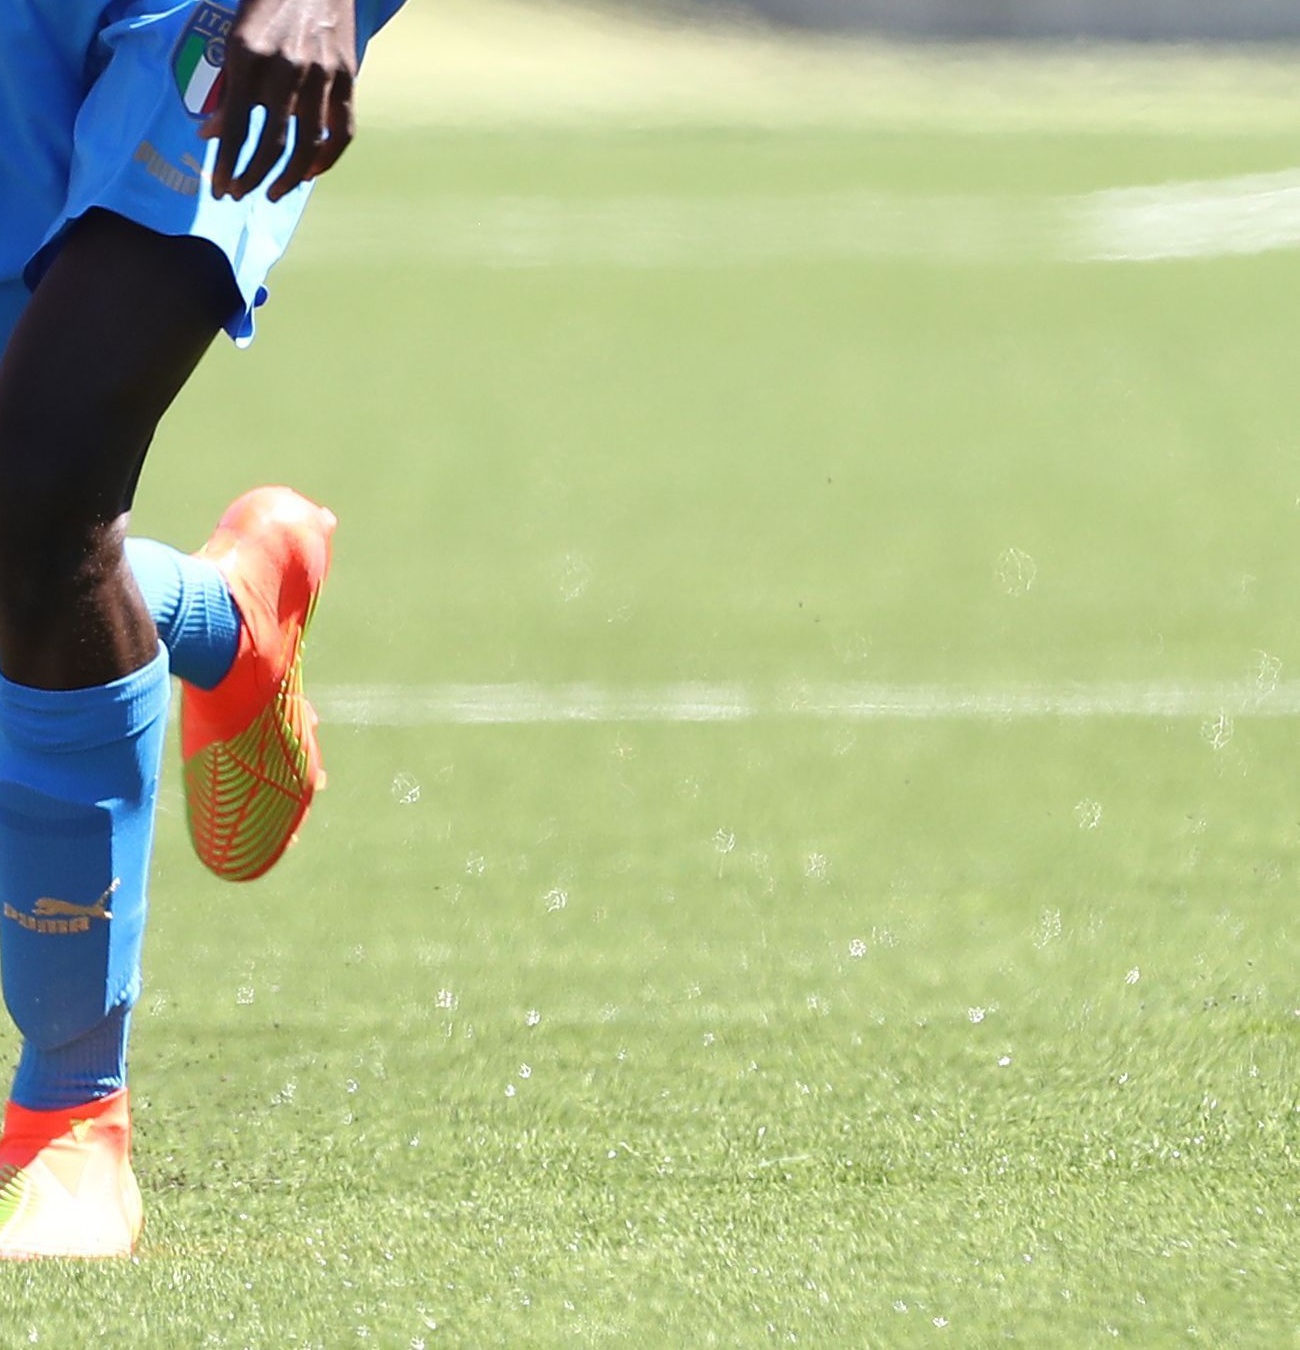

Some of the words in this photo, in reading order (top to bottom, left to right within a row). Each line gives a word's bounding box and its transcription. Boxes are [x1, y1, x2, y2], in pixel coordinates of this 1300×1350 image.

[199, 8, 234, 37] ITA
[133, 139, 201, 196] PUMA
[3, 901, 90, 935] PUMA
